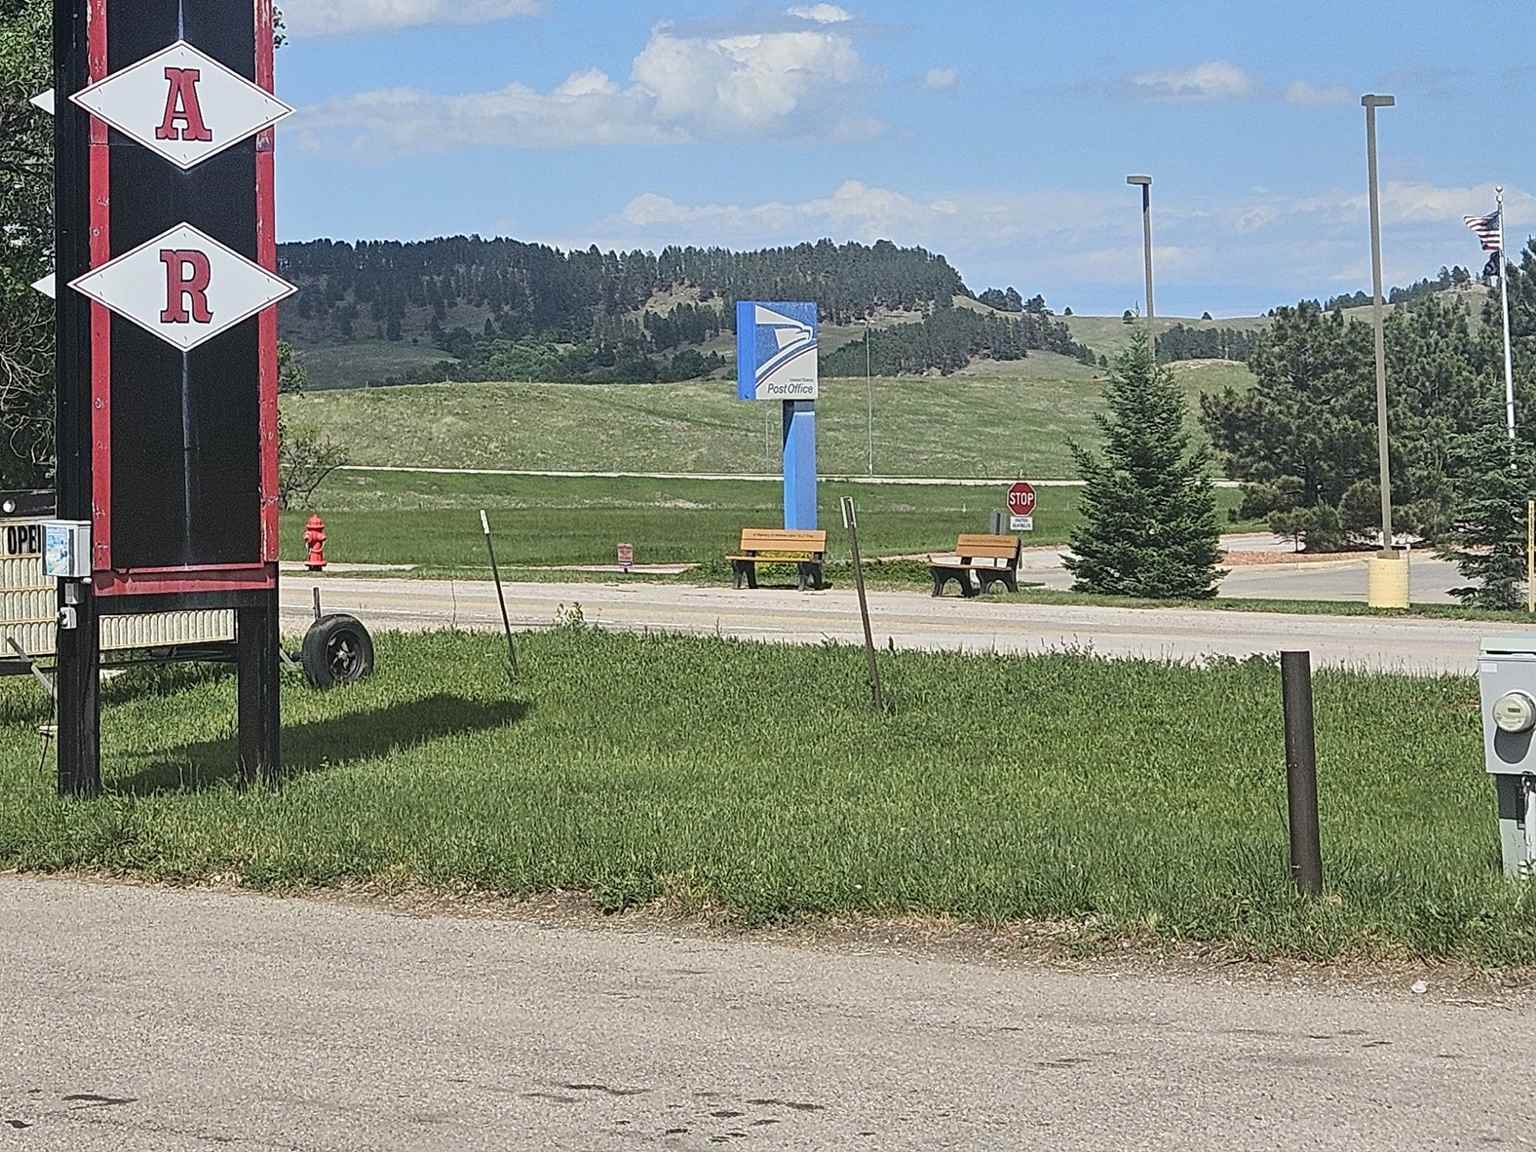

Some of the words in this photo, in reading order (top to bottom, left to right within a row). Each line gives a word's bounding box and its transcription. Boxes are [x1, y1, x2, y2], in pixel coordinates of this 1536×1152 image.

[767, 383, 787, 394] Post
[787, 383, 814, 394] Office
[1009, 492, 1034, 506] STOP
